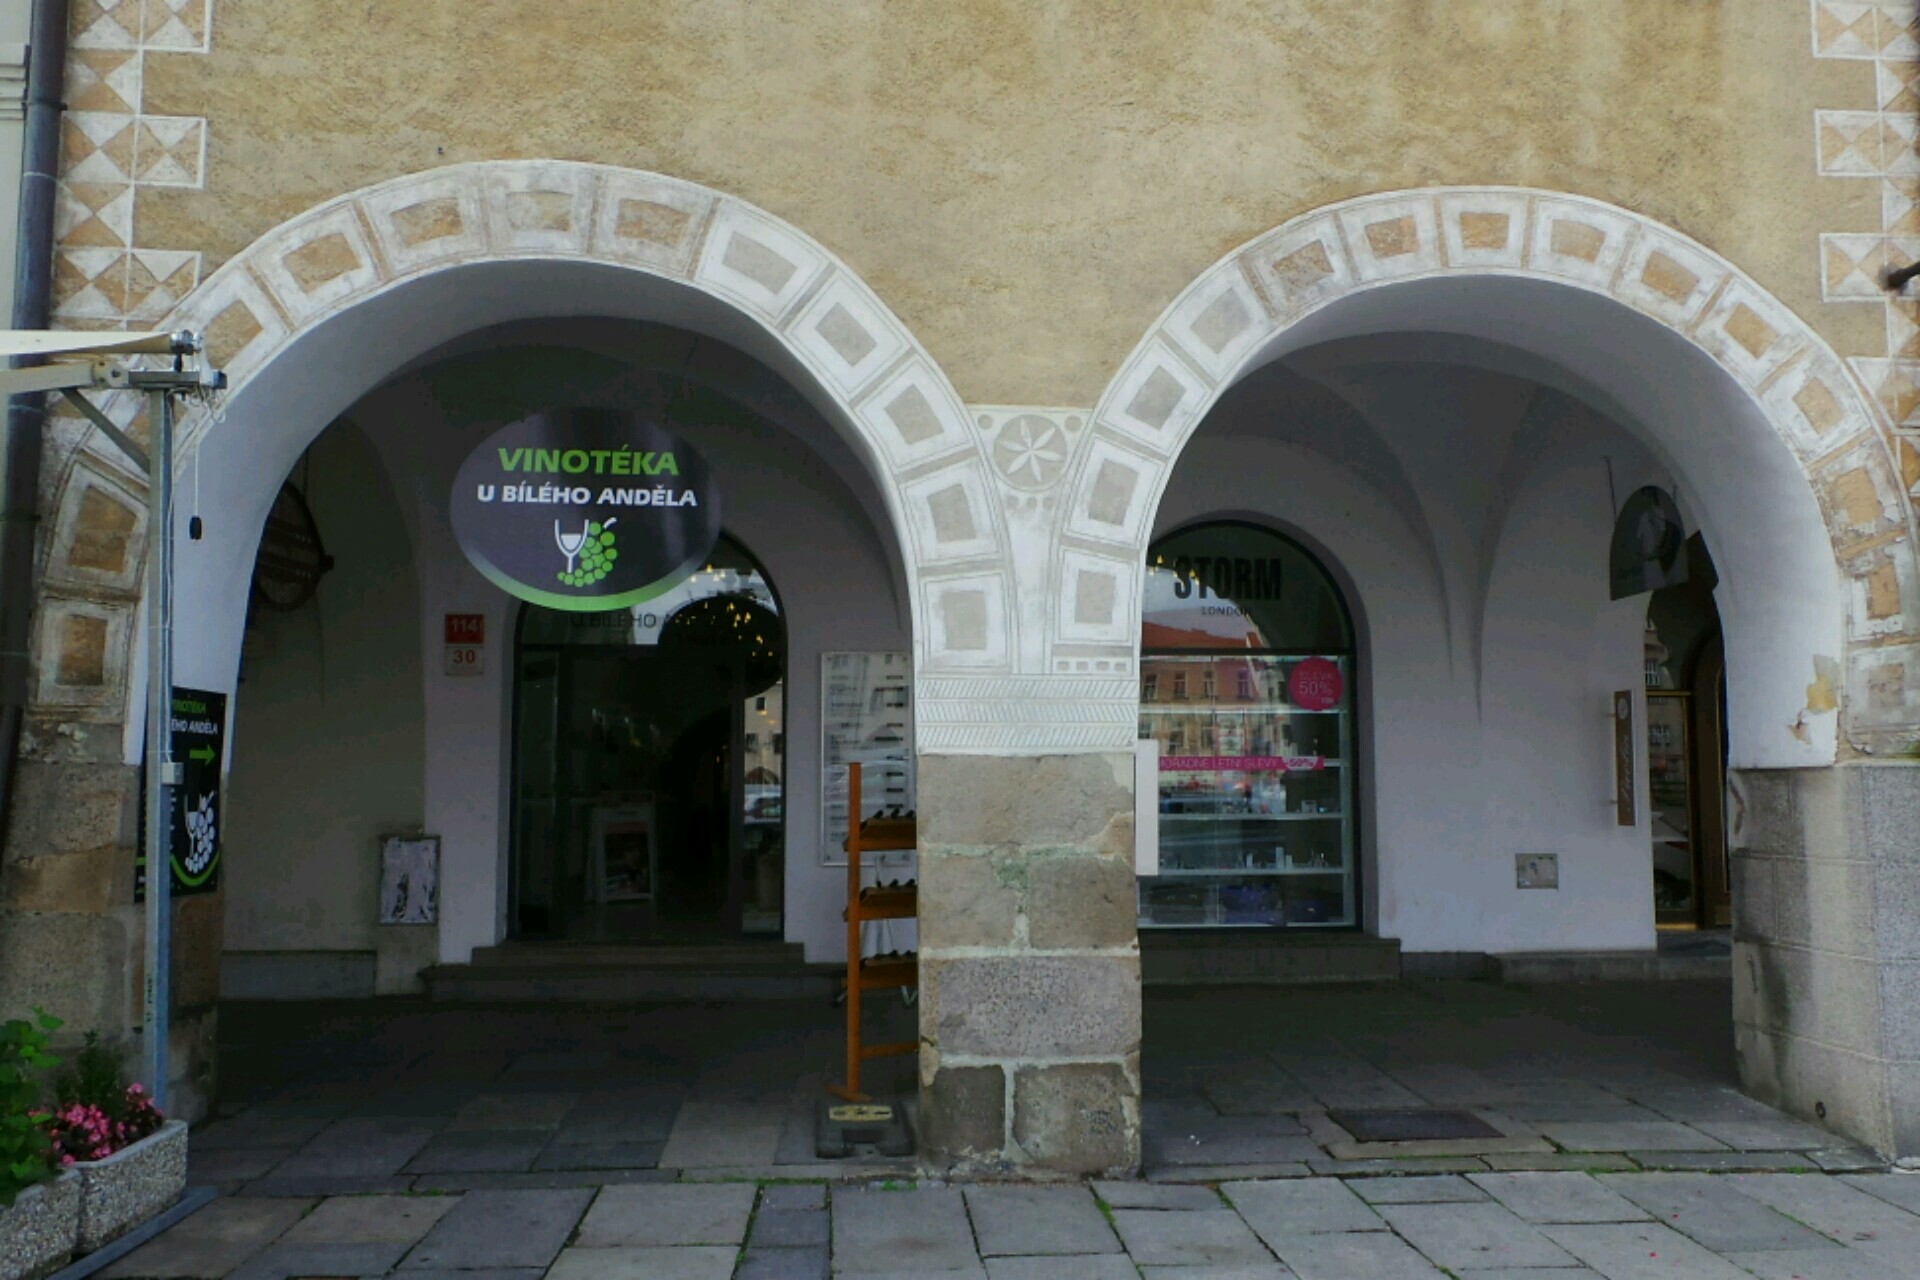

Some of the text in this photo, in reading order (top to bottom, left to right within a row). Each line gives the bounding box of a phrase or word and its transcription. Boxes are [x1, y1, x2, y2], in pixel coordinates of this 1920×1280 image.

[498, 444, 679, 475] VINOTÉKA
[477, 480, 697, 507] U BÍLÉHO ANDĚLA
[1175, 556, 1281, 599] STORM
[1201, 606, 1253, 616] LONDON
[451, 617, 480, 633] 114
[454, 649, 475, 664] 30
[1299, 681, 1334, 696] 50%
